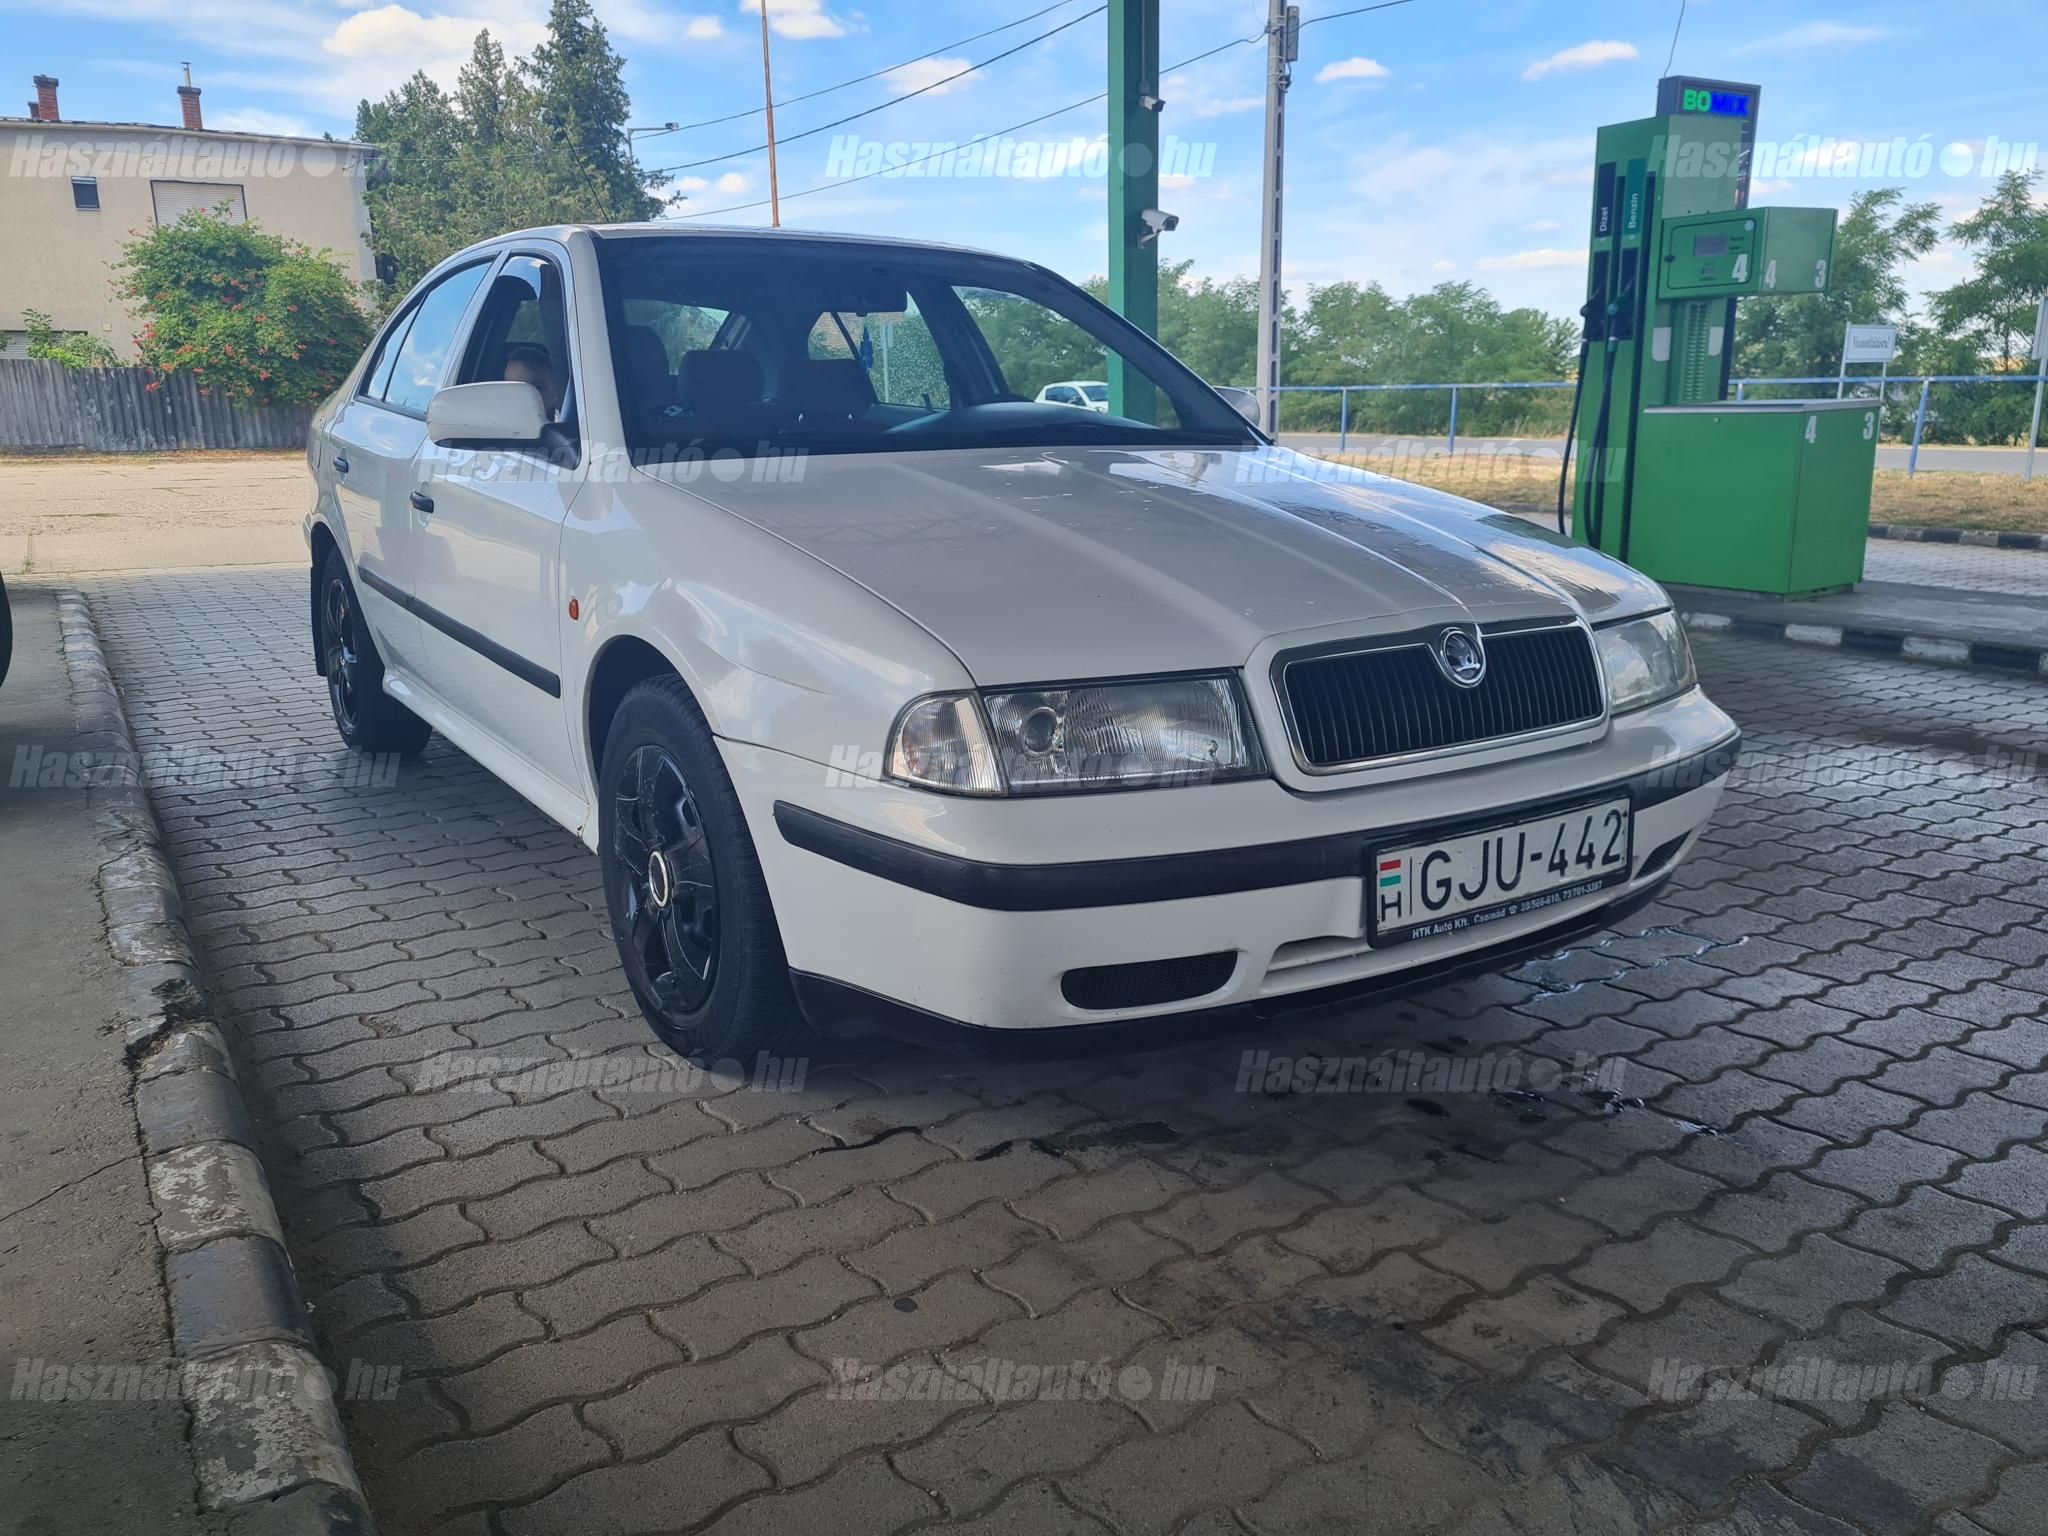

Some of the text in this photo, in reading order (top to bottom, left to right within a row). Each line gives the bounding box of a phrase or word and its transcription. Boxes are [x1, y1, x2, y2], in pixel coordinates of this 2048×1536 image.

[1683, 89, 1749, 117] BOMIX
[1600, 207, 1609, 232] Dizel
[1628, 193, 1639, 229] Benzin
[1732, 253, 1748, 283] 4
[1765, 260, 1777, 289] 4
[1815, 260, 1826, 288] 3
[1805, 415, 1817, 443] 4
[1863, 412, 1875, 440] 3
[1421, 809, 1622, 911] GJU-442
[1381, 891, 1401, 922] H
[1412, 926, 1431, 939] HTK
[1454, 917, 1470, 929] Kft.
